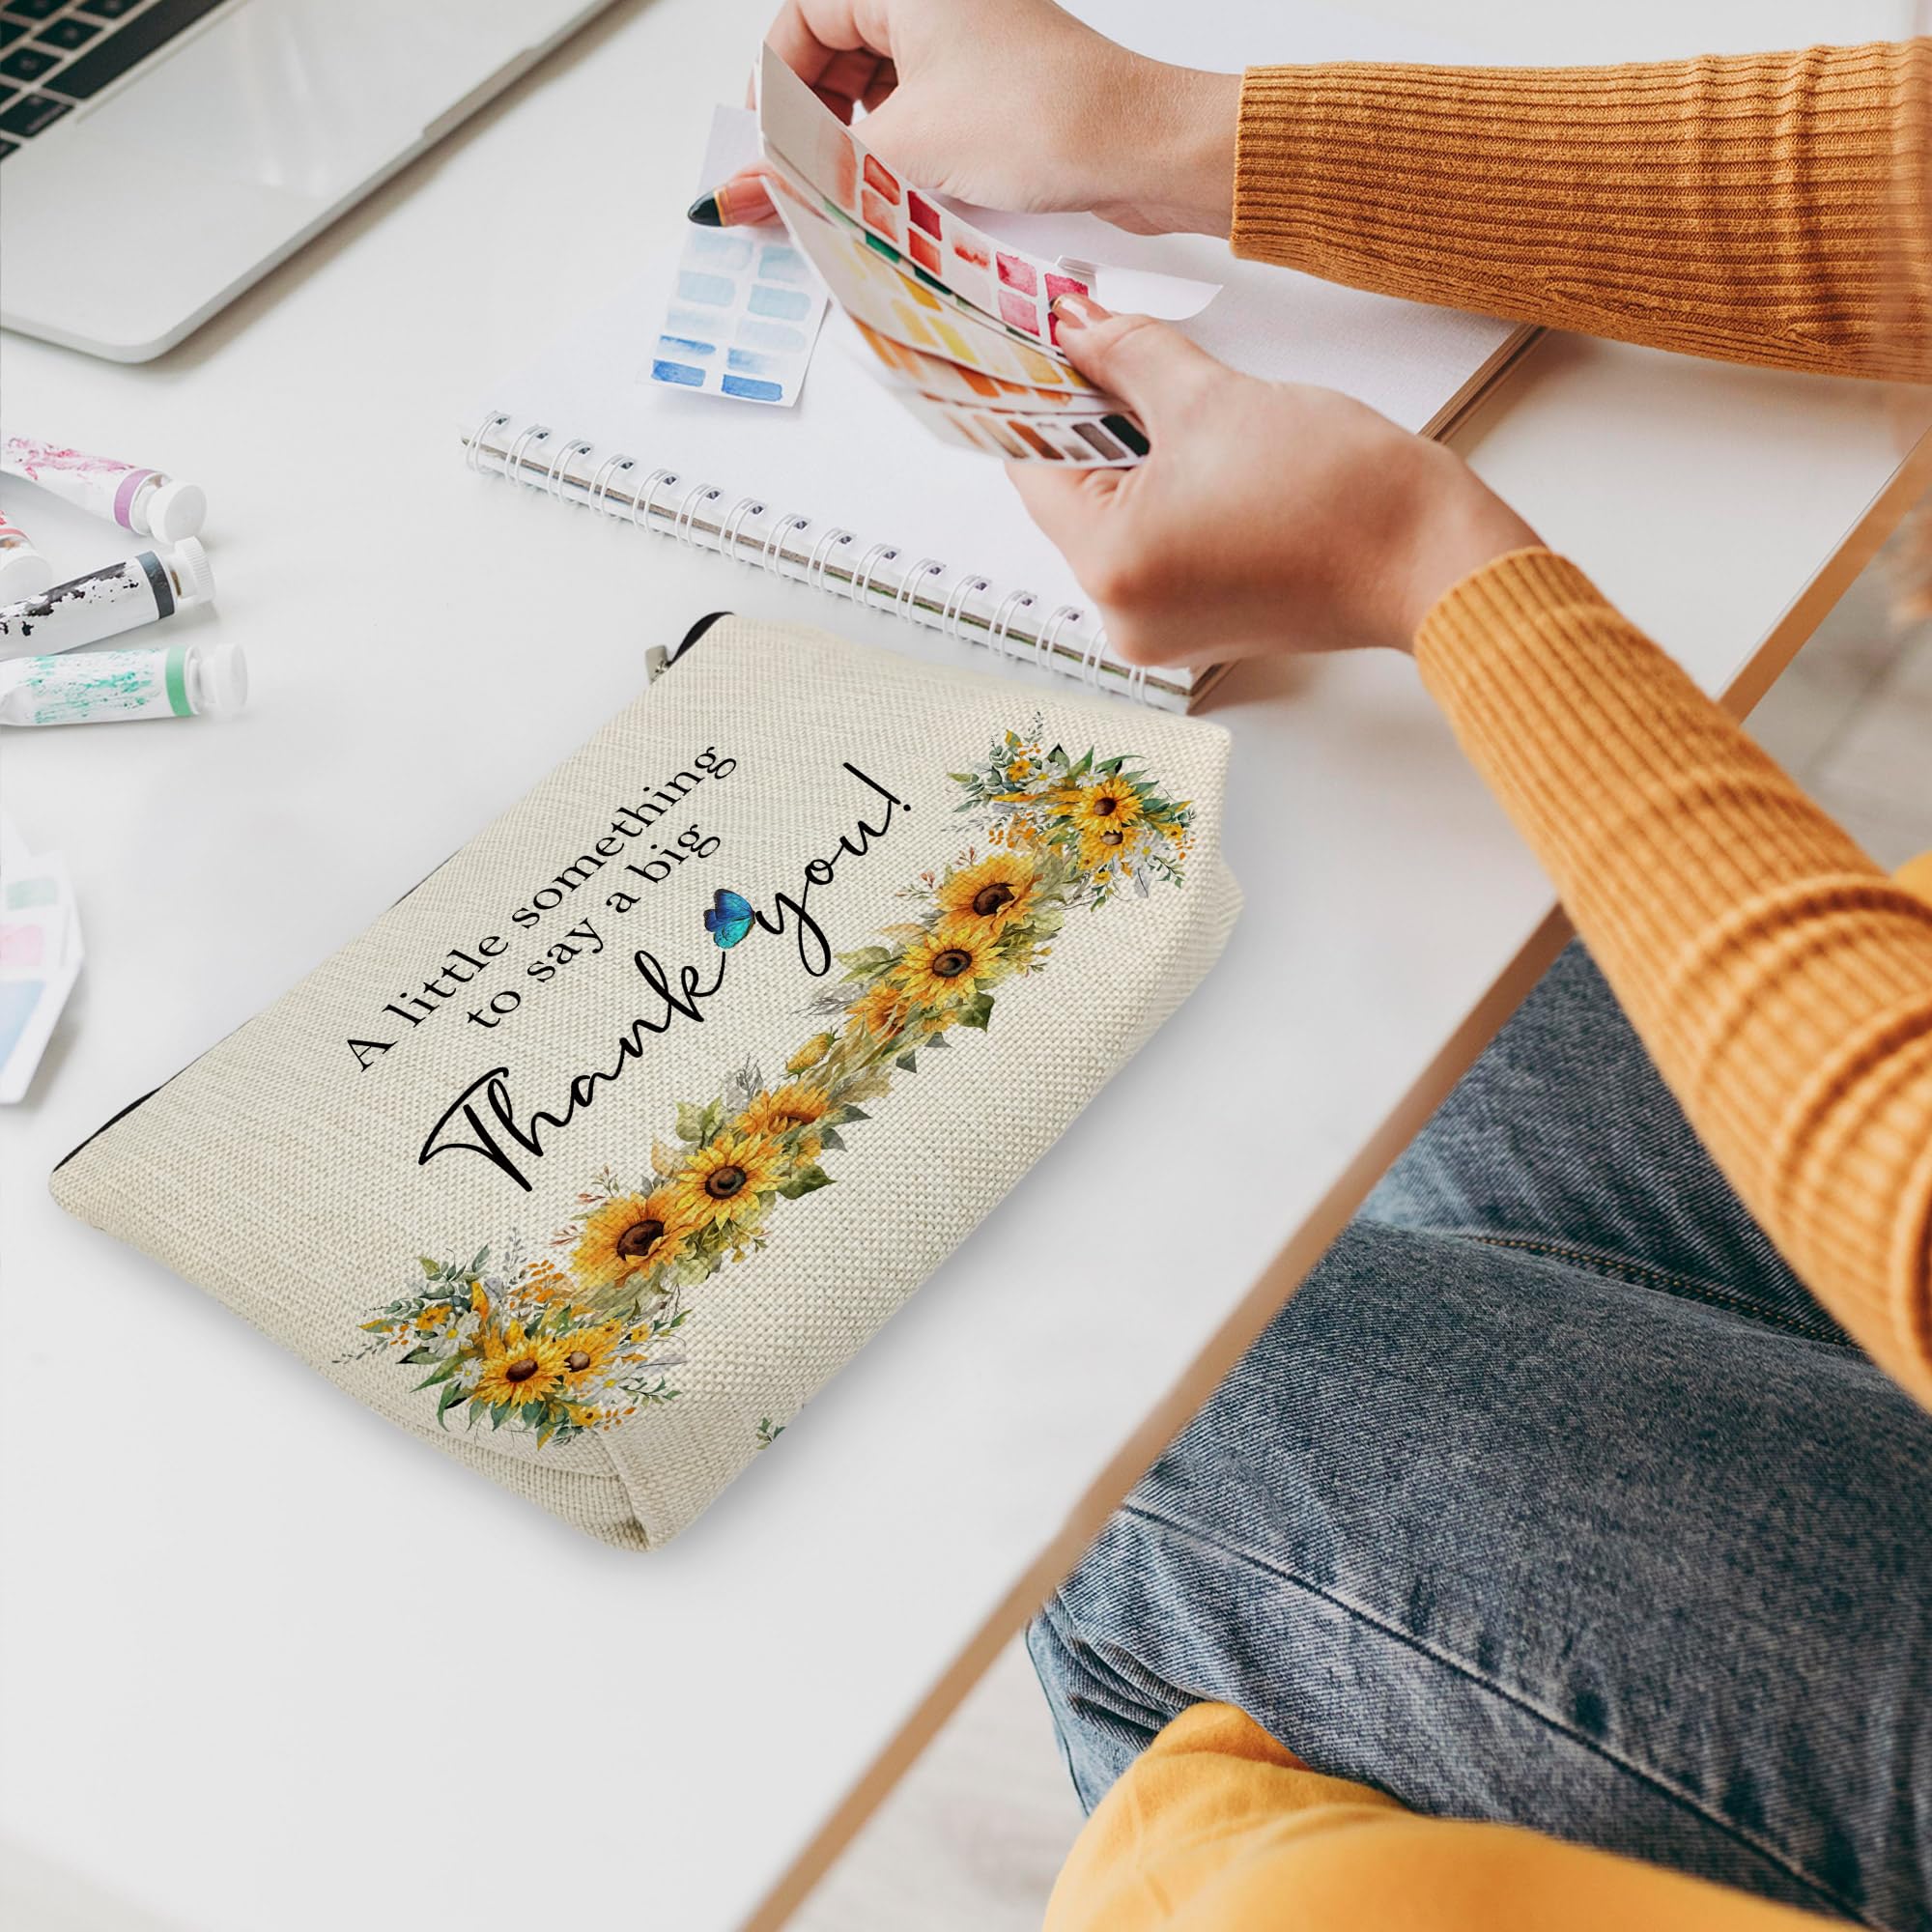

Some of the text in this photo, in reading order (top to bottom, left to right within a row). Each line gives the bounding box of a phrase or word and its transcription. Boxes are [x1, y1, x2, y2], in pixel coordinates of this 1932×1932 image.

[346, 746, 738, 1074] A little something
[417, 760, 913, 1194] Thank you!
[467, 823, 723, 1030] to say a big
